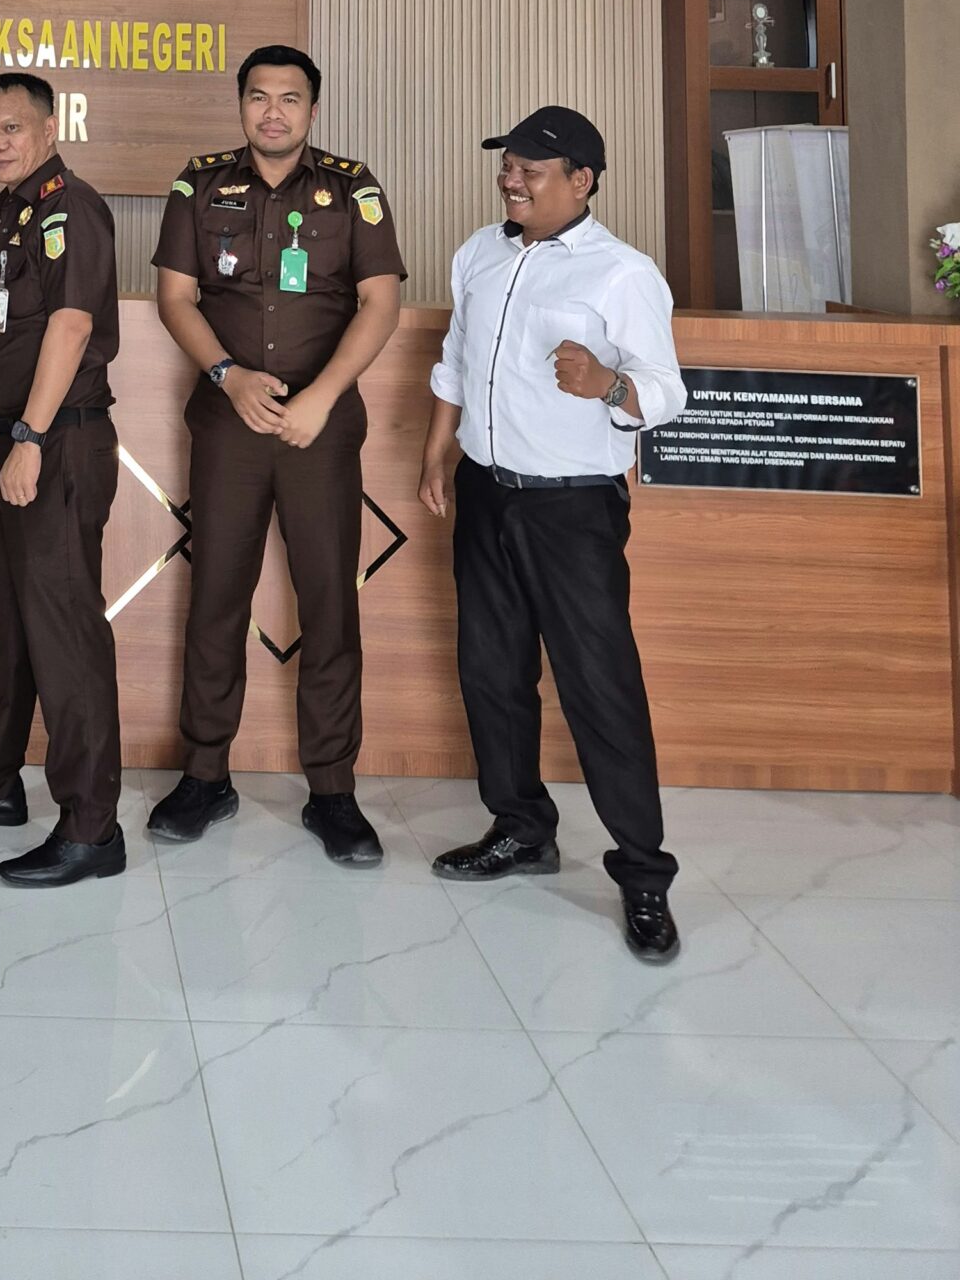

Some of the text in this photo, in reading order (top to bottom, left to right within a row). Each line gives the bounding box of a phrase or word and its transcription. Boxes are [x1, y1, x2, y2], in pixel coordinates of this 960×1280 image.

[109, 22, 227, 73] NEGERI
[693, 390, 863, 407] UNTUK KENYAMANAN BERSAMA
[683, 416, 716, 425] IDENTITAS
[717, 418, 743, 426] KEPADA
[743, 419, 775, 427] PETUGAS
[710, 410, 733, 418] UNTUK
[733, 411, 765, 419] MELAPOR
[774, 412, 792, 420] MEJA
[792, 413, 828, 421] INFORMASI
[679, 431, 709, 440] DIMOHON
[710, 433, 733, 441] UNTUK
[733, 434, 776, 442] BERPAKAIAN
[794, 436, 817, 444] SOPAN
[818, 437, 832, 445] DAN
[833, 438, 880, 447] MENGENAKAN
[880, 440, 905, 448] SEPATU
[660, 446, 678, 454] TAMU
[679, 447, 709, 455] DIMOHON
[710, 448, 750, 457] MENITIPKAN
[768, 451, 809, 459] KOMUNIKASI
[810, 452, 824, 460] DAN
[825, 453, 853, 461] BARANG
[854, 454, 896, 463] ELEKTRONIK
[660, 454, 688, 462] LAINNYA
[696, 455, 721, 463] LEMARI
[740, 457, 764, 465] SUDAH
[764, 458, 804, 466] DISEDIAKAN
